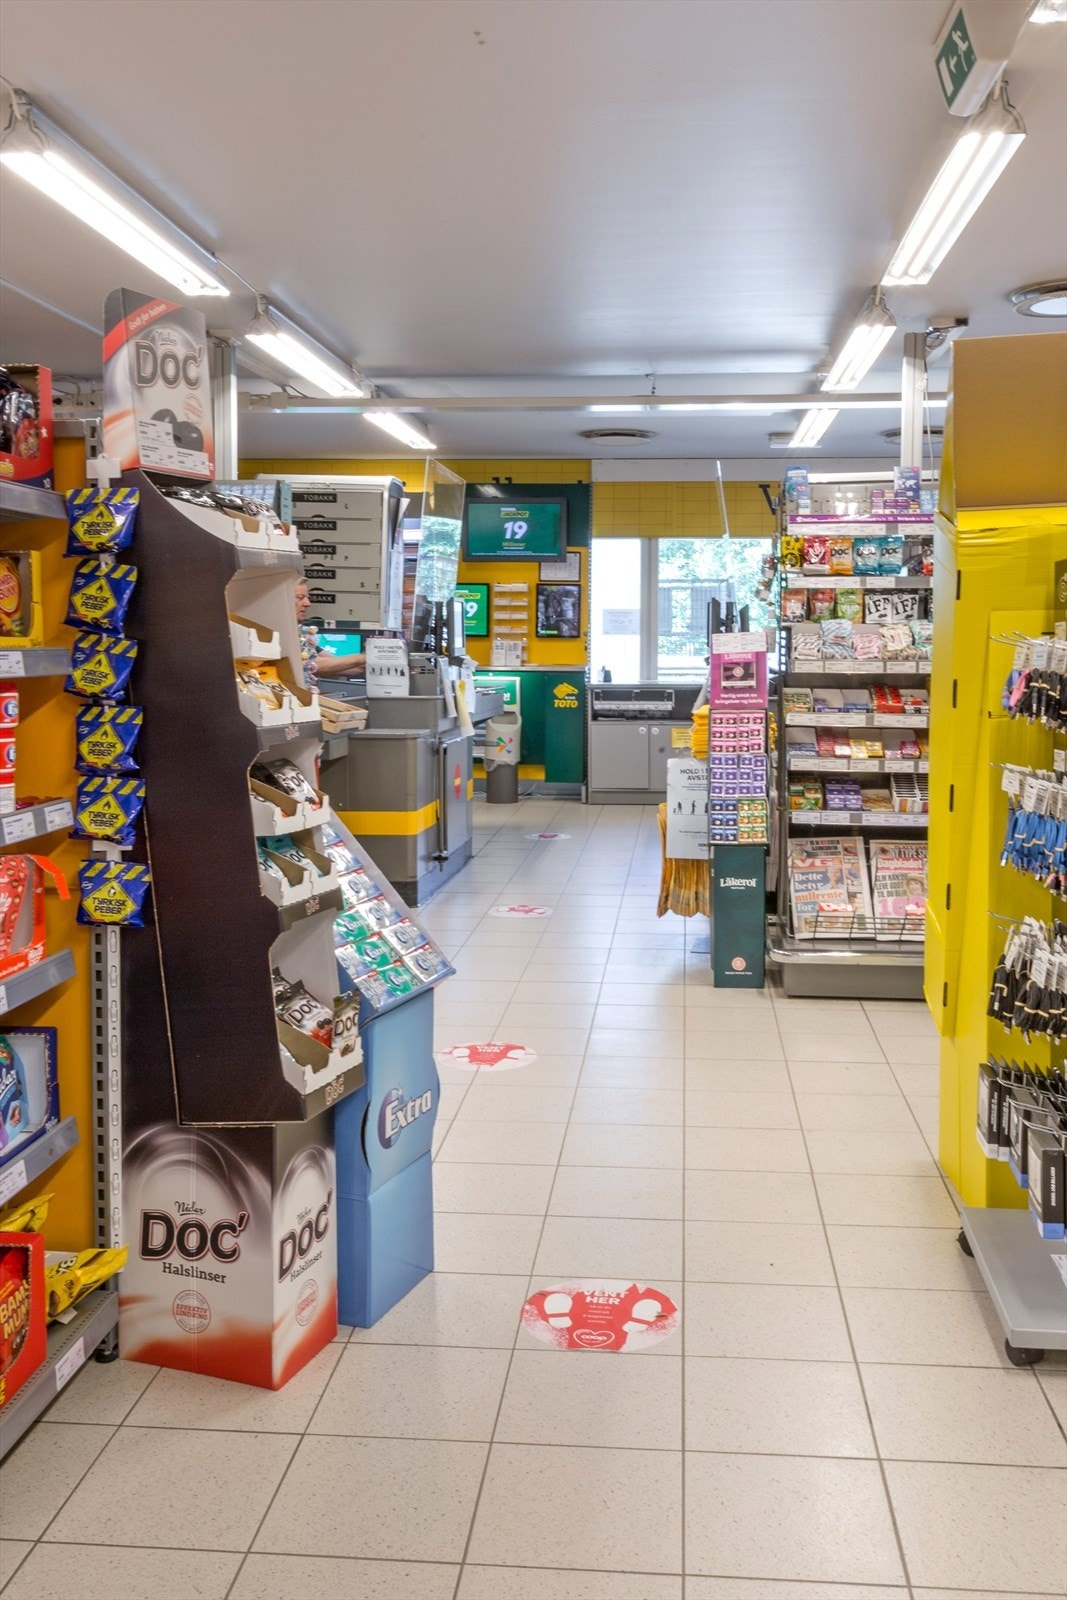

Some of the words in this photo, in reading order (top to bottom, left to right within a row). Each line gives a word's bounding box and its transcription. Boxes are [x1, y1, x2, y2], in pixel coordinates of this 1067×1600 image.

[504, 521, 528, 539] 19
[554, 699, 578, 708] TOTO
[87, 741, 118, 749] TYRKISK
[87, 811, 120, 821] TYRKISK
[89, 818, 114, 828] PEBER
[793, 858, 833, 867] VG
[91, 897, 127, 907] TYRKISK
[94, 905, 122, 914] PEBER
[384, 1089, 432, 1139] Extra
[161, 1261, 227, 1284] Halslinser
[583, 1290, 629, 1298] VENT
[585, 1296, 621, 1305] HER
